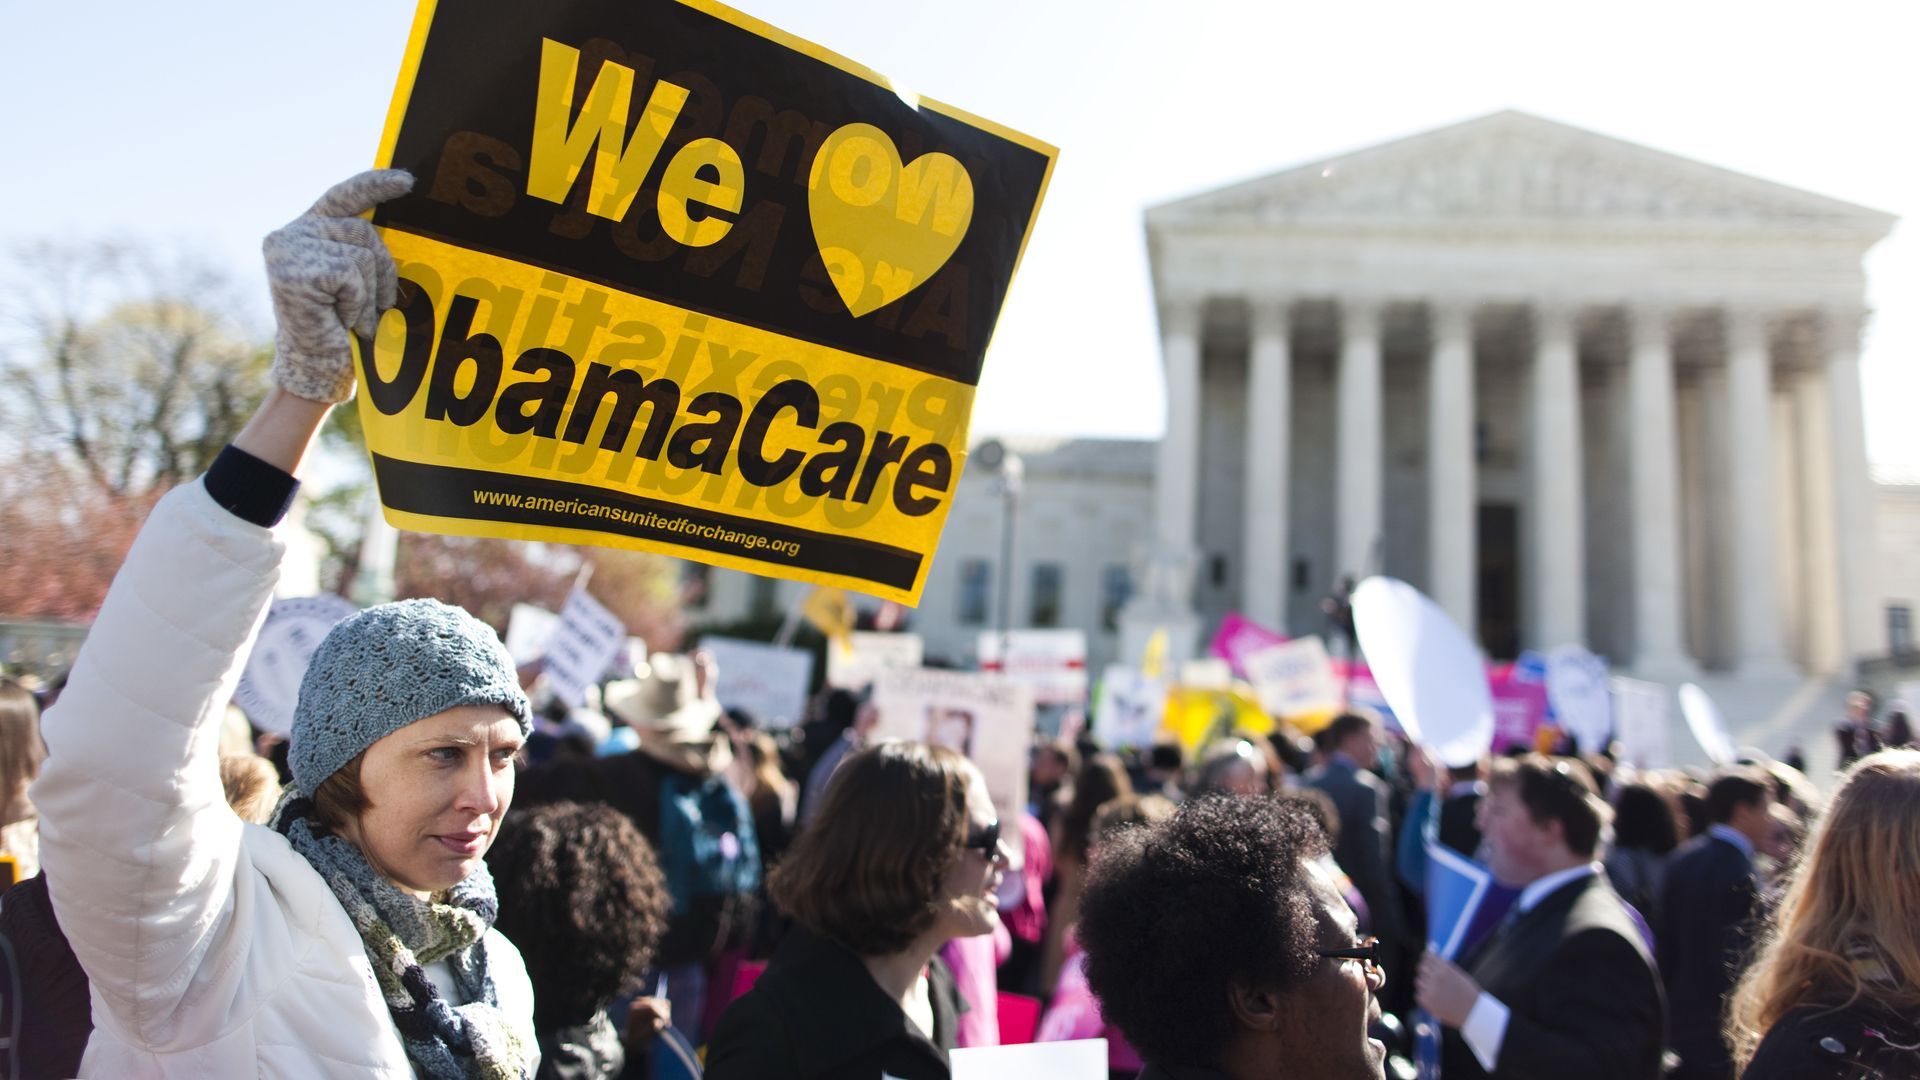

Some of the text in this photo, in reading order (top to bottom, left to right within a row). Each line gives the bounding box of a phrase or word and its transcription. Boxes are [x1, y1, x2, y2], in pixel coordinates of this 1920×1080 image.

[526, 36, 745, 248] We
[357, 276, 953, 517] ObamaCare
[472, 488, 801, 557] www.americansunitedforchange.org
